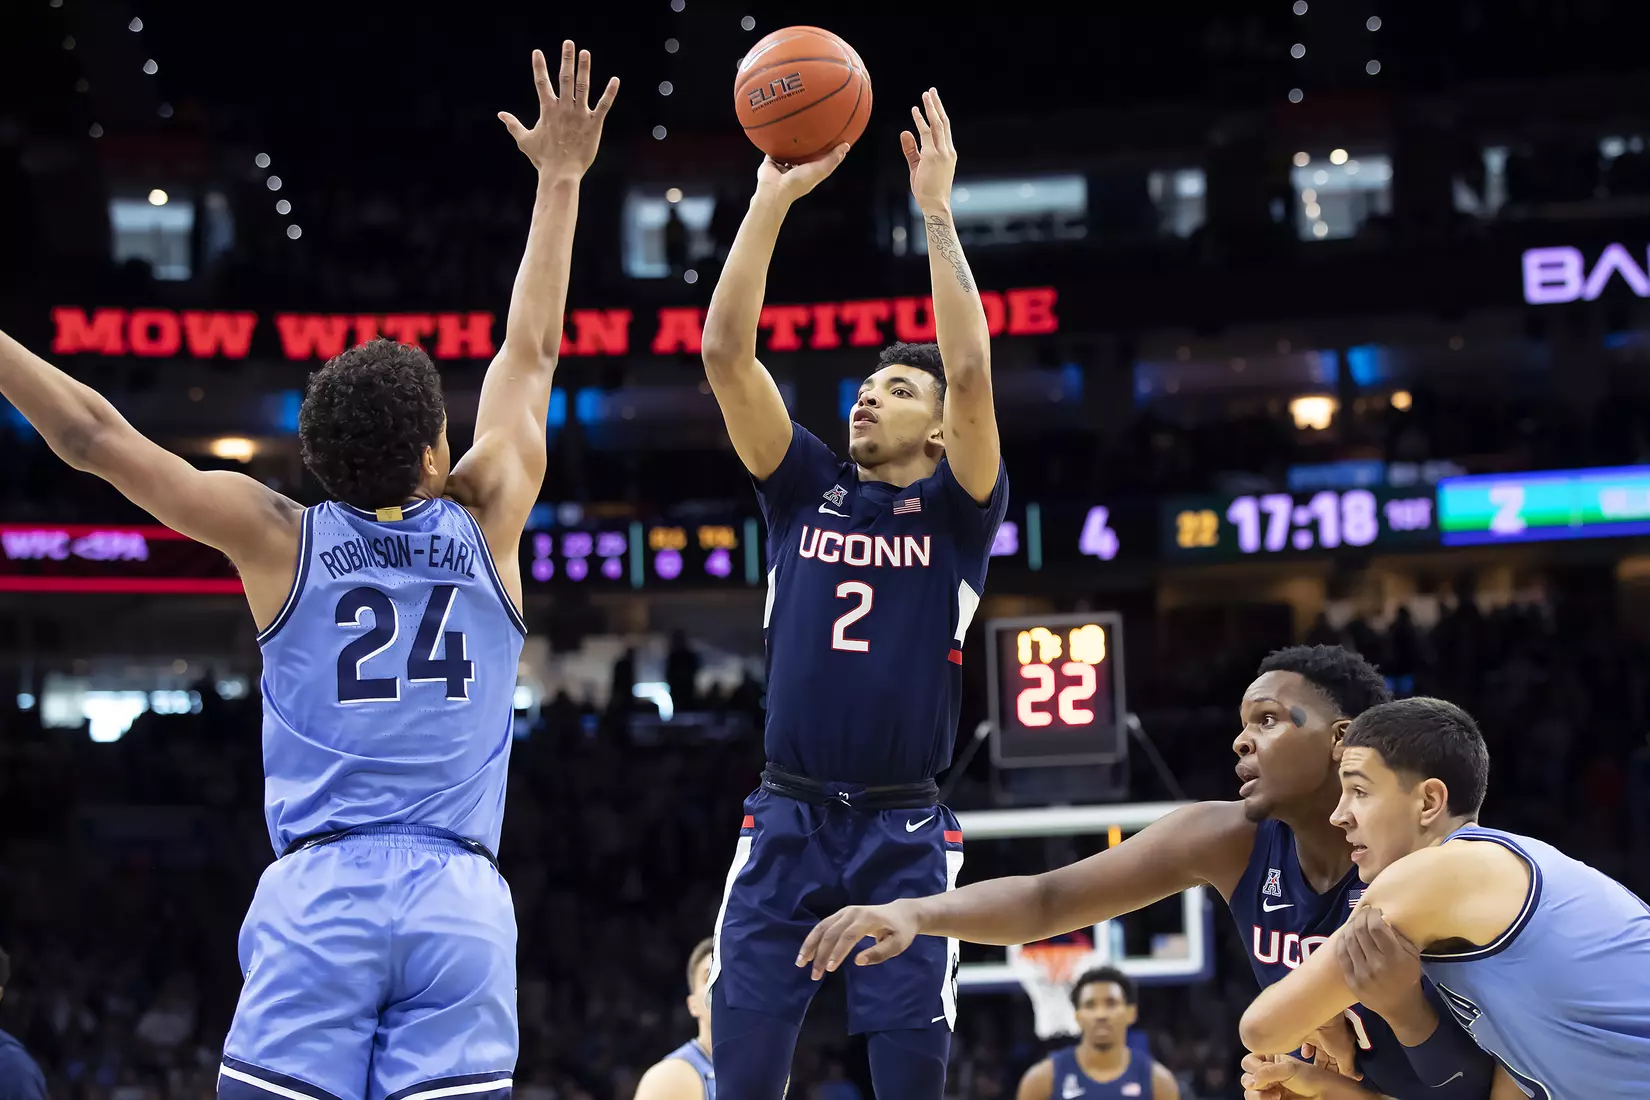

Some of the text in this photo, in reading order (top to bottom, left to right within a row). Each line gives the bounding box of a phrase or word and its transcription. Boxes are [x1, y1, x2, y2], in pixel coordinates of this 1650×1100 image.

[747, 71, 803, 106] ELITE
[1521, 242, 1650, 305] BA
[51, 286, 1059, 360] MOW WITH N ATITUE
[799, 524, 932, 568] UCONN
[1078, 504, 1119, 560] 4
[1226, 490, 1379, 553] 17:18
[319, 534, 477, 580] ROBINSON-EARL
[335, 585, 476, 704] 24
[831, 579, 874, 652] 2
[1017, 662, 1097, 727] 22
